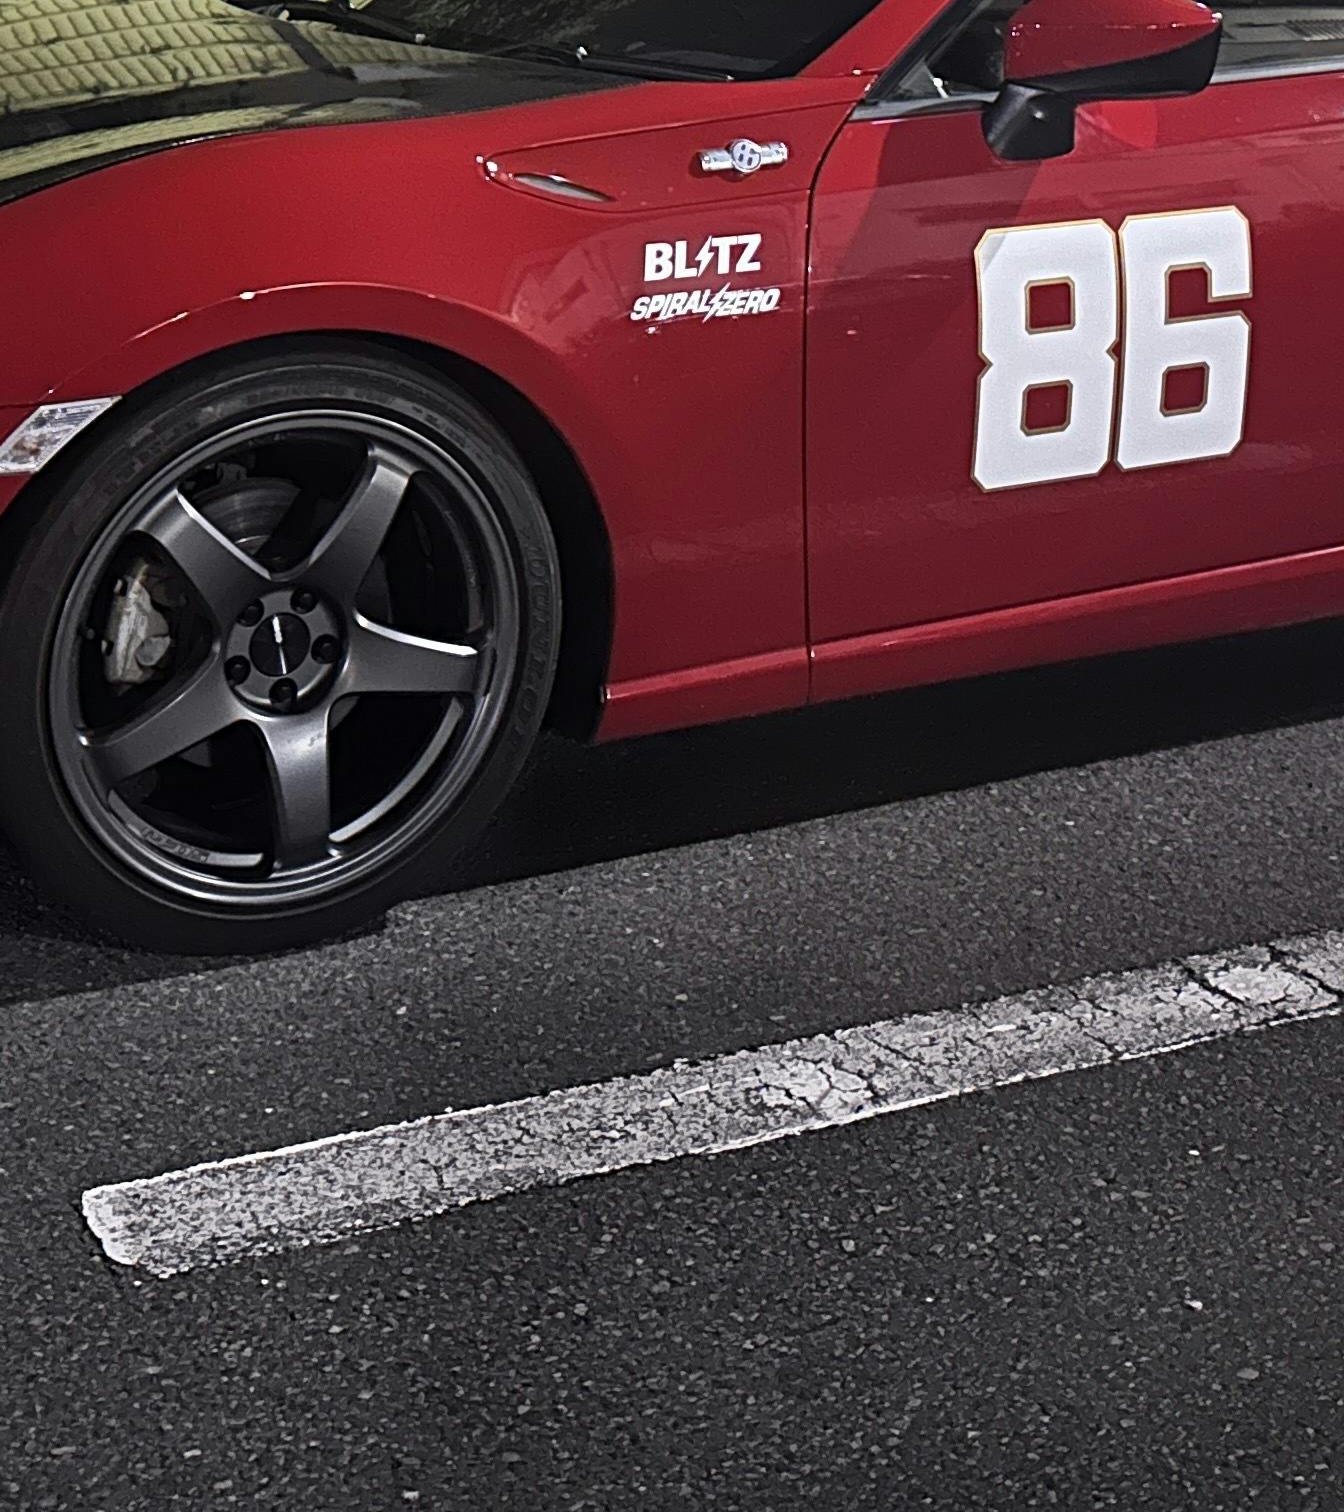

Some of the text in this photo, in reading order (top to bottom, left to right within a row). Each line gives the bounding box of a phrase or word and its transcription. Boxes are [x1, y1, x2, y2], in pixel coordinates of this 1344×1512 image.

[733, 141, 762, 169] 86
[643, 233, 762, 282] BLITZ
[971, 205, 1253, 493] 86
